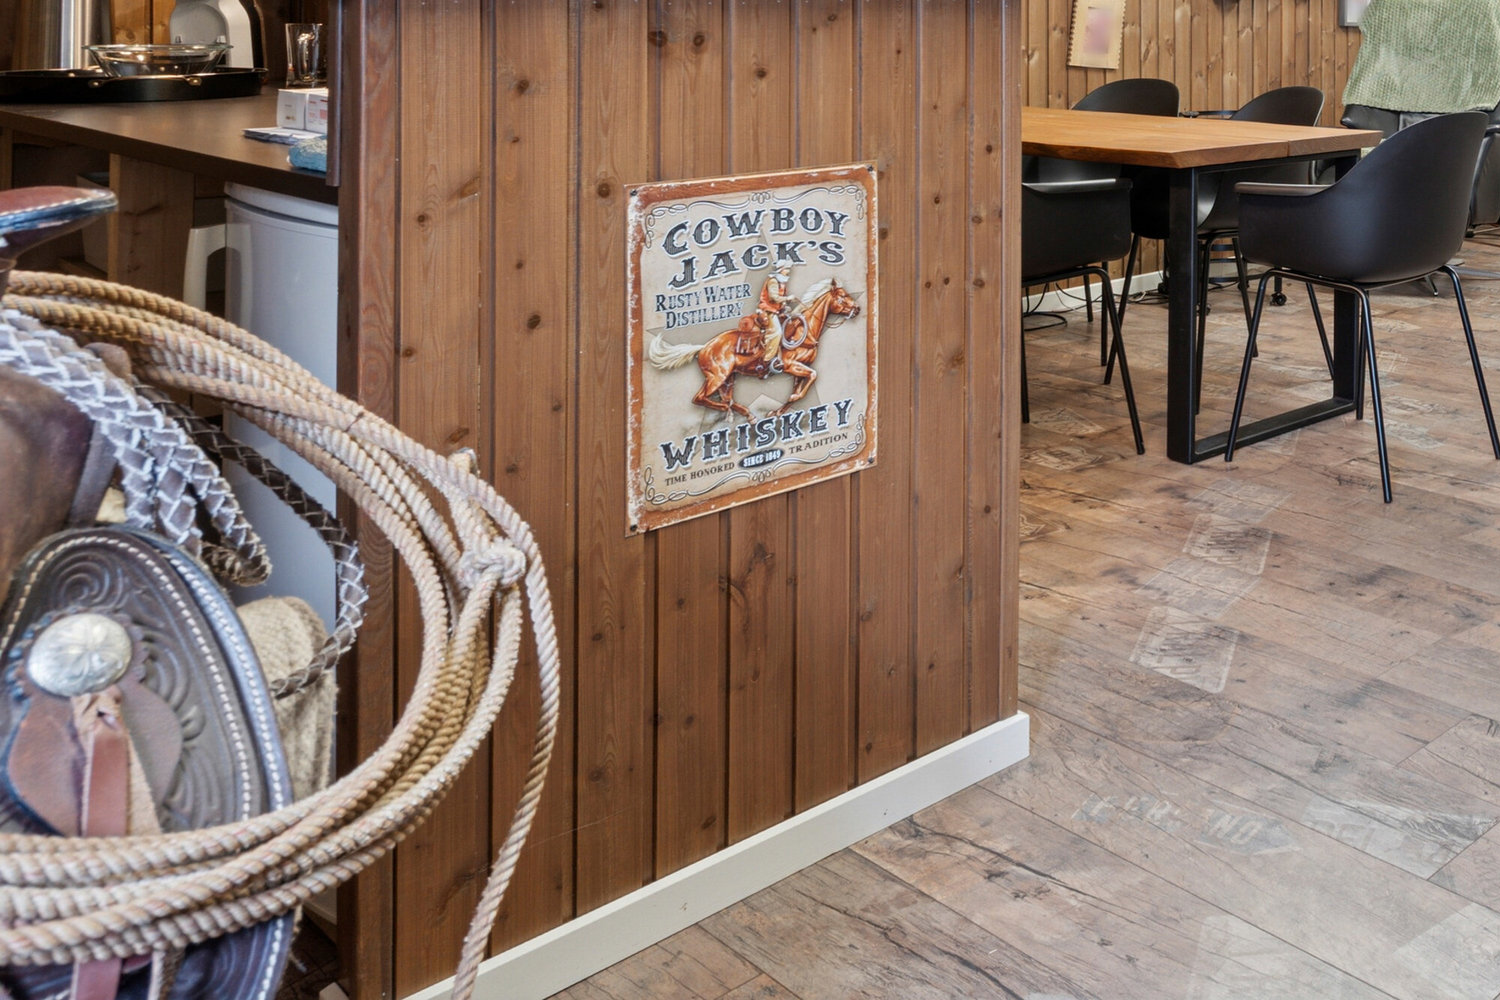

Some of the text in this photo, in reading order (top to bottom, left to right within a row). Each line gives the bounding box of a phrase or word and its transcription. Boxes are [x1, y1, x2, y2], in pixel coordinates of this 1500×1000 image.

[662, 207, 849, 256] COWBOY
[668, 241, 845, 288] JACK'S
[655, 283, 751, 312] RUSTY WATER
[665, 301, 744, 329] DISTILLERY
[660, 399, 853, 470] WHISKEY
[665, 474, 688, 486] TIME
[690, 462, 735, 480] HONORED
[743, 453, 765, 468] SINCE
[789, 432, 849, 454] TRADITION
